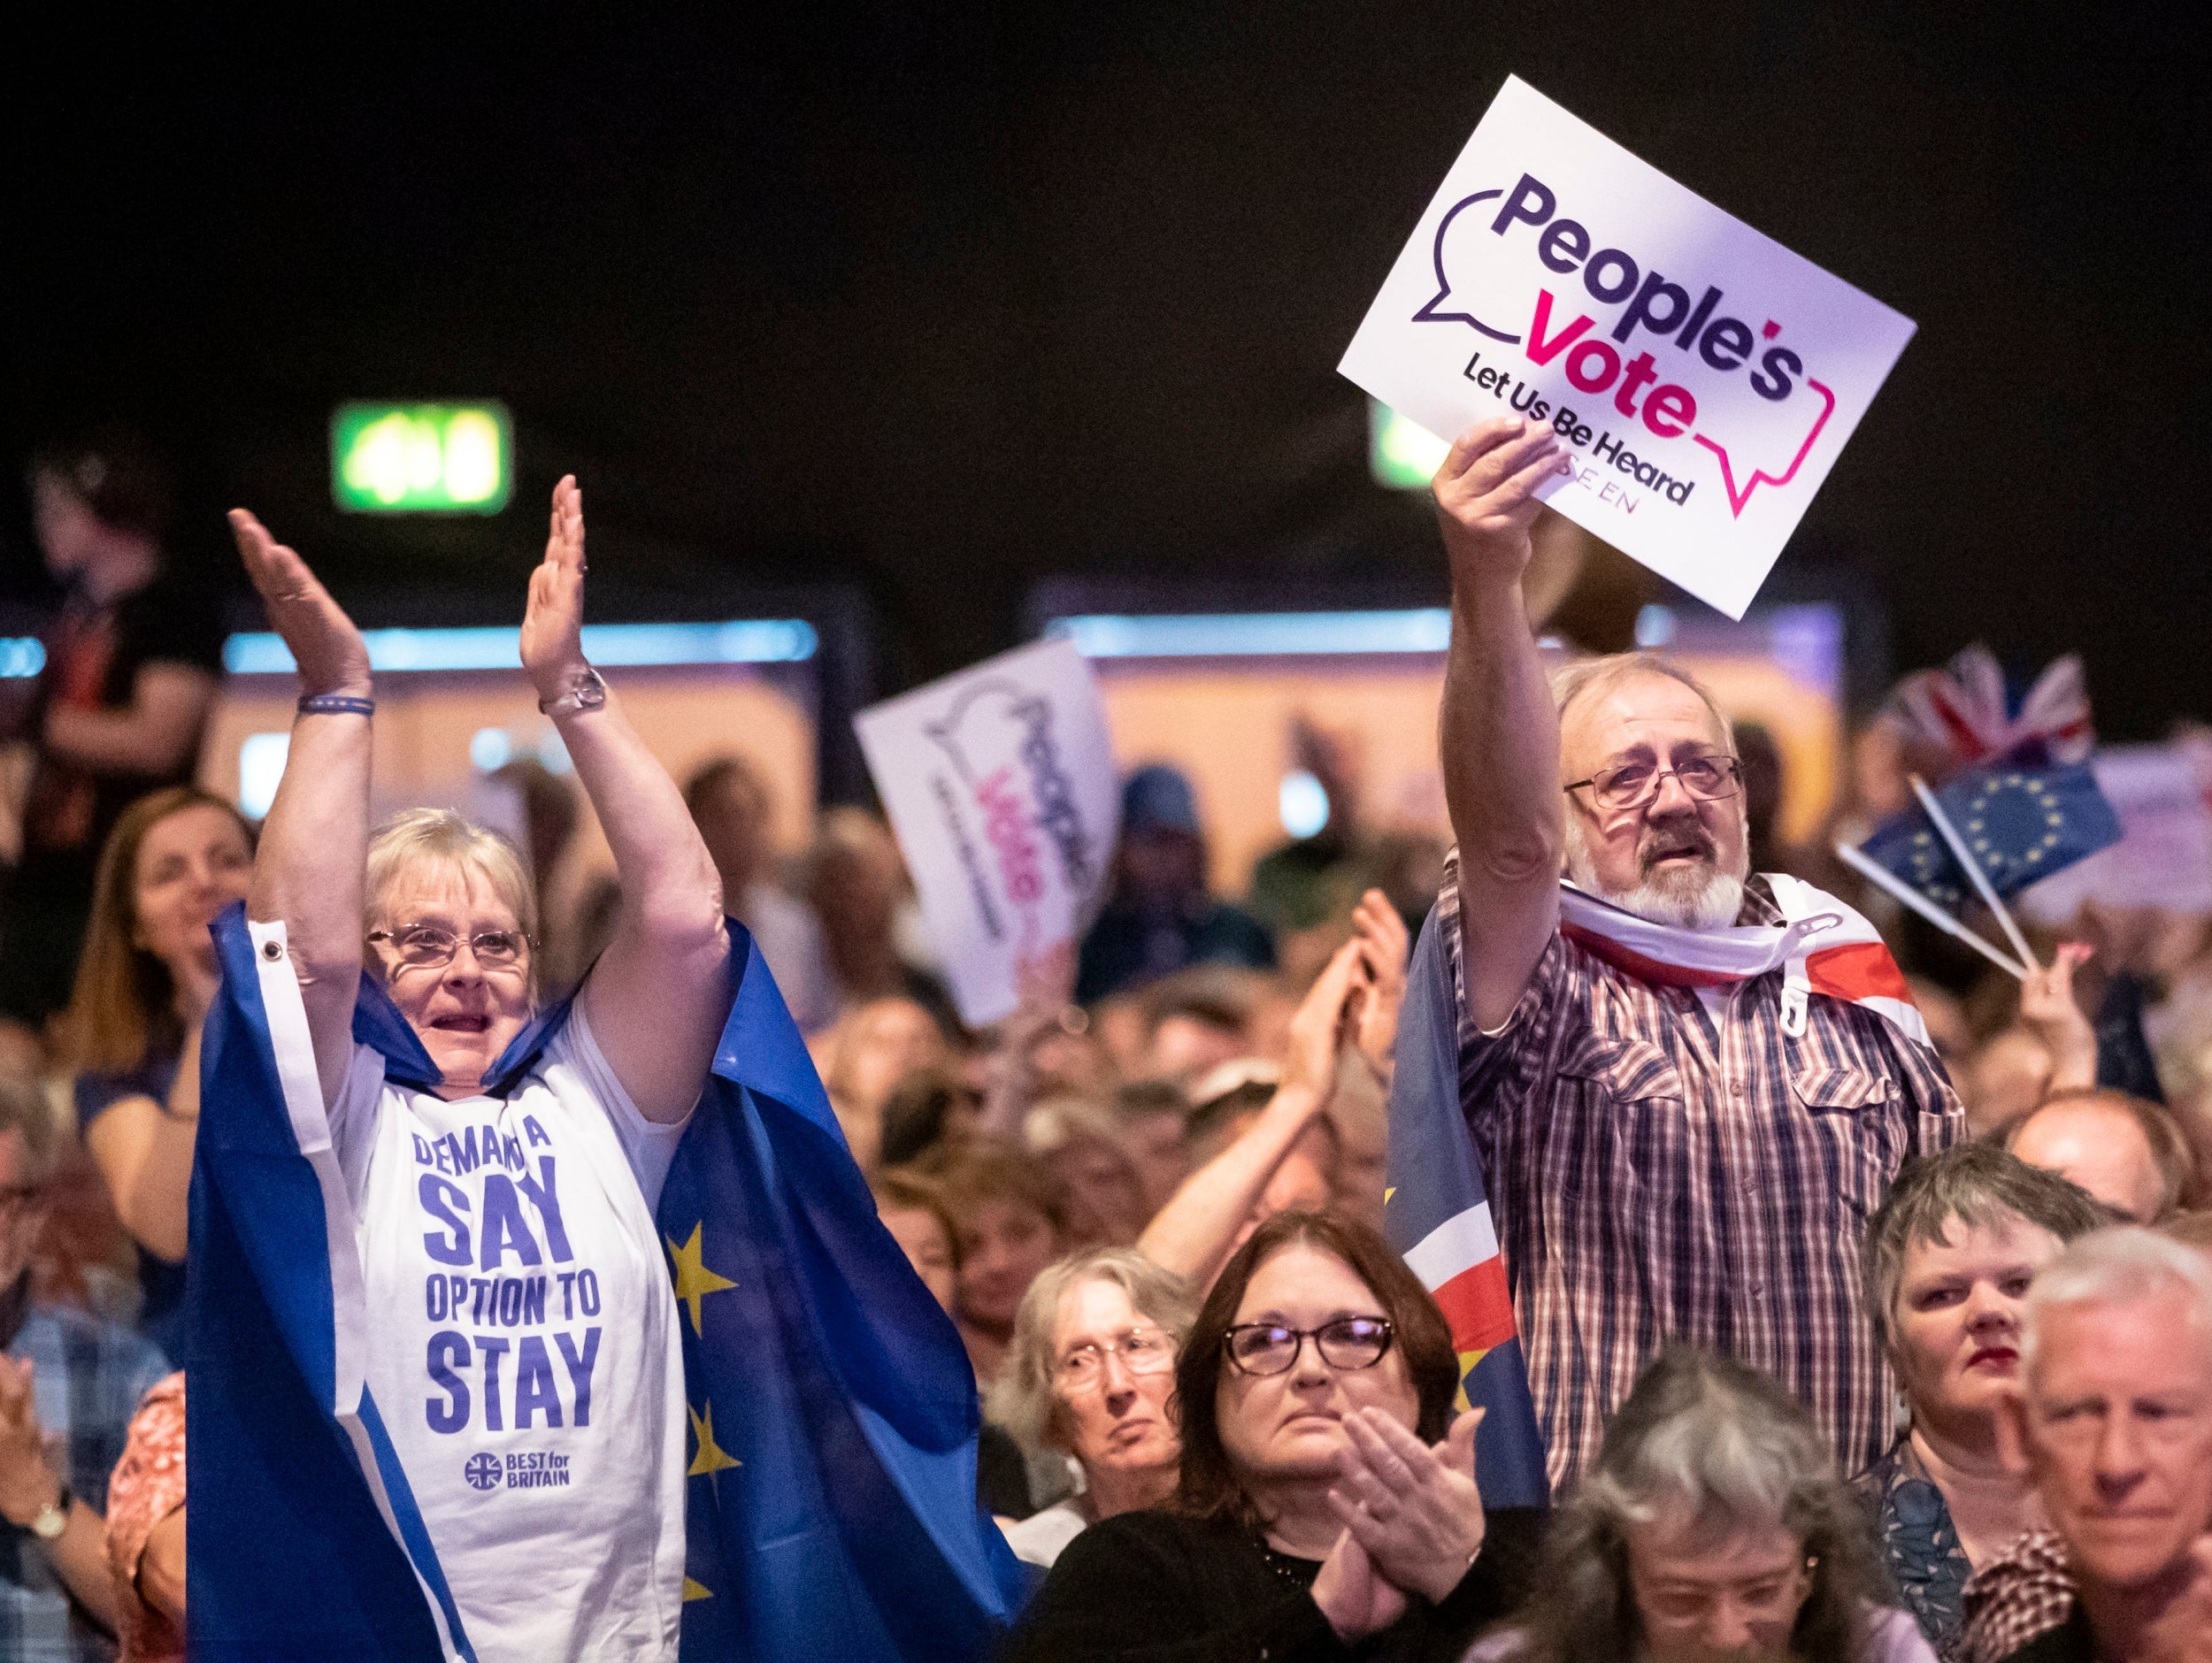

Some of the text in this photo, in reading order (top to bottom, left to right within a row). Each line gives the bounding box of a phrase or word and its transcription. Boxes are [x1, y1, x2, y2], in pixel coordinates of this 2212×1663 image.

[1490, 172, 1803, 402] People's
[1525, 287, 1697, 439] Vote
[1463, 351, 1695, 507] Let Us Be Heard
[522, 1115, 552, 1147] A
[418, 1155, 574, 1273] SAY
[426, 1268, 602, 1327] OPTION TO
[426, 1327, 602, 1435] STAY
[506, 1451, 570, 1470] BEST for
[507, 1468, 570, 1488] BRITAIN
